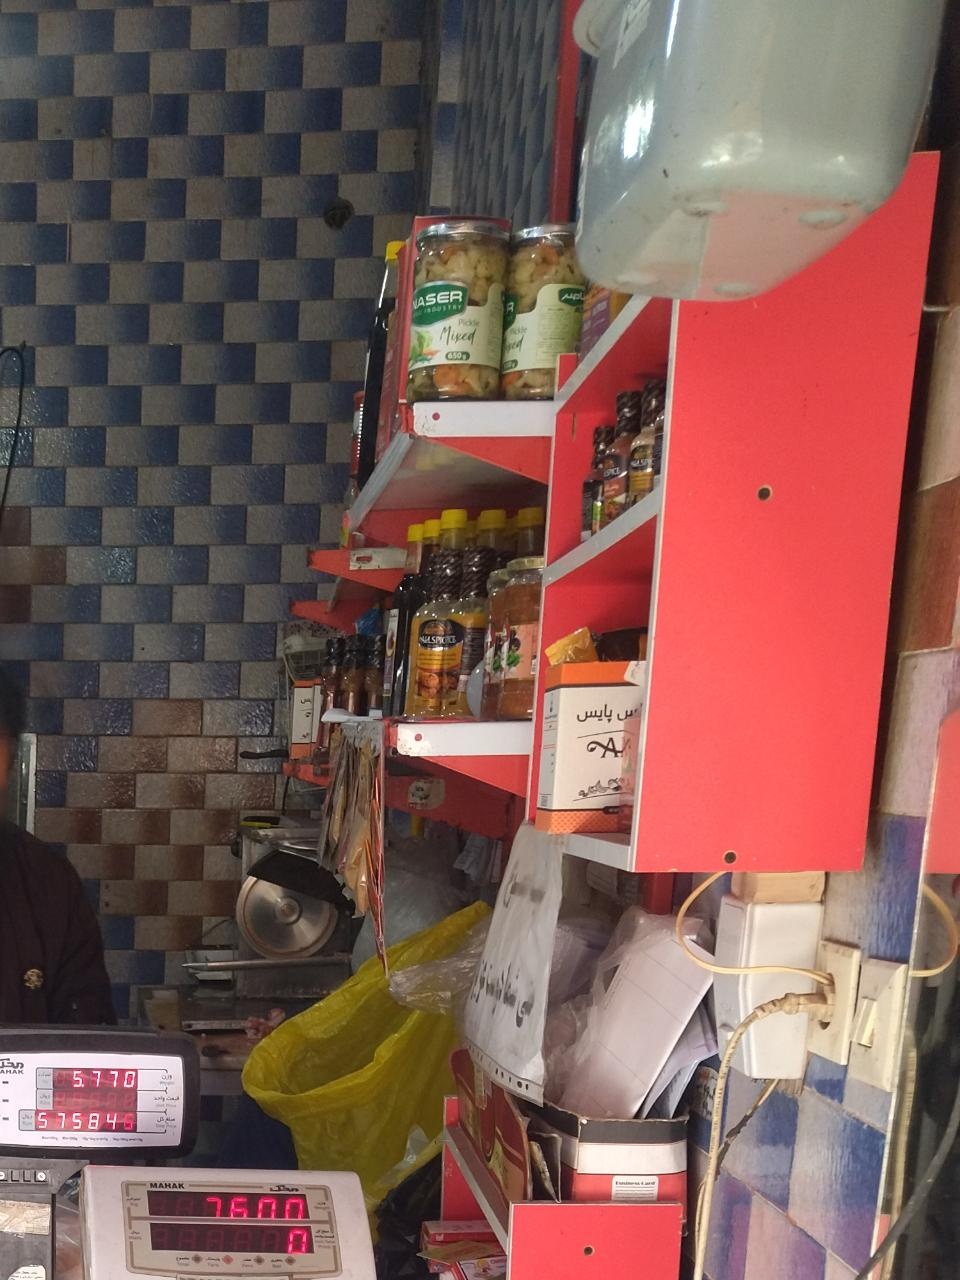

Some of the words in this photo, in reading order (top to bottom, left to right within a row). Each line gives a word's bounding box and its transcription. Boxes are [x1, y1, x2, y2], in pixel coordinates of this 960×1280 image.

[72, 1070, 136, 1088] 5.770
[149, 1182, 185, 1190] MAHAK
[206, 1196, 305, 1220] 7600
[287, 1230, 308, 1254] 0
